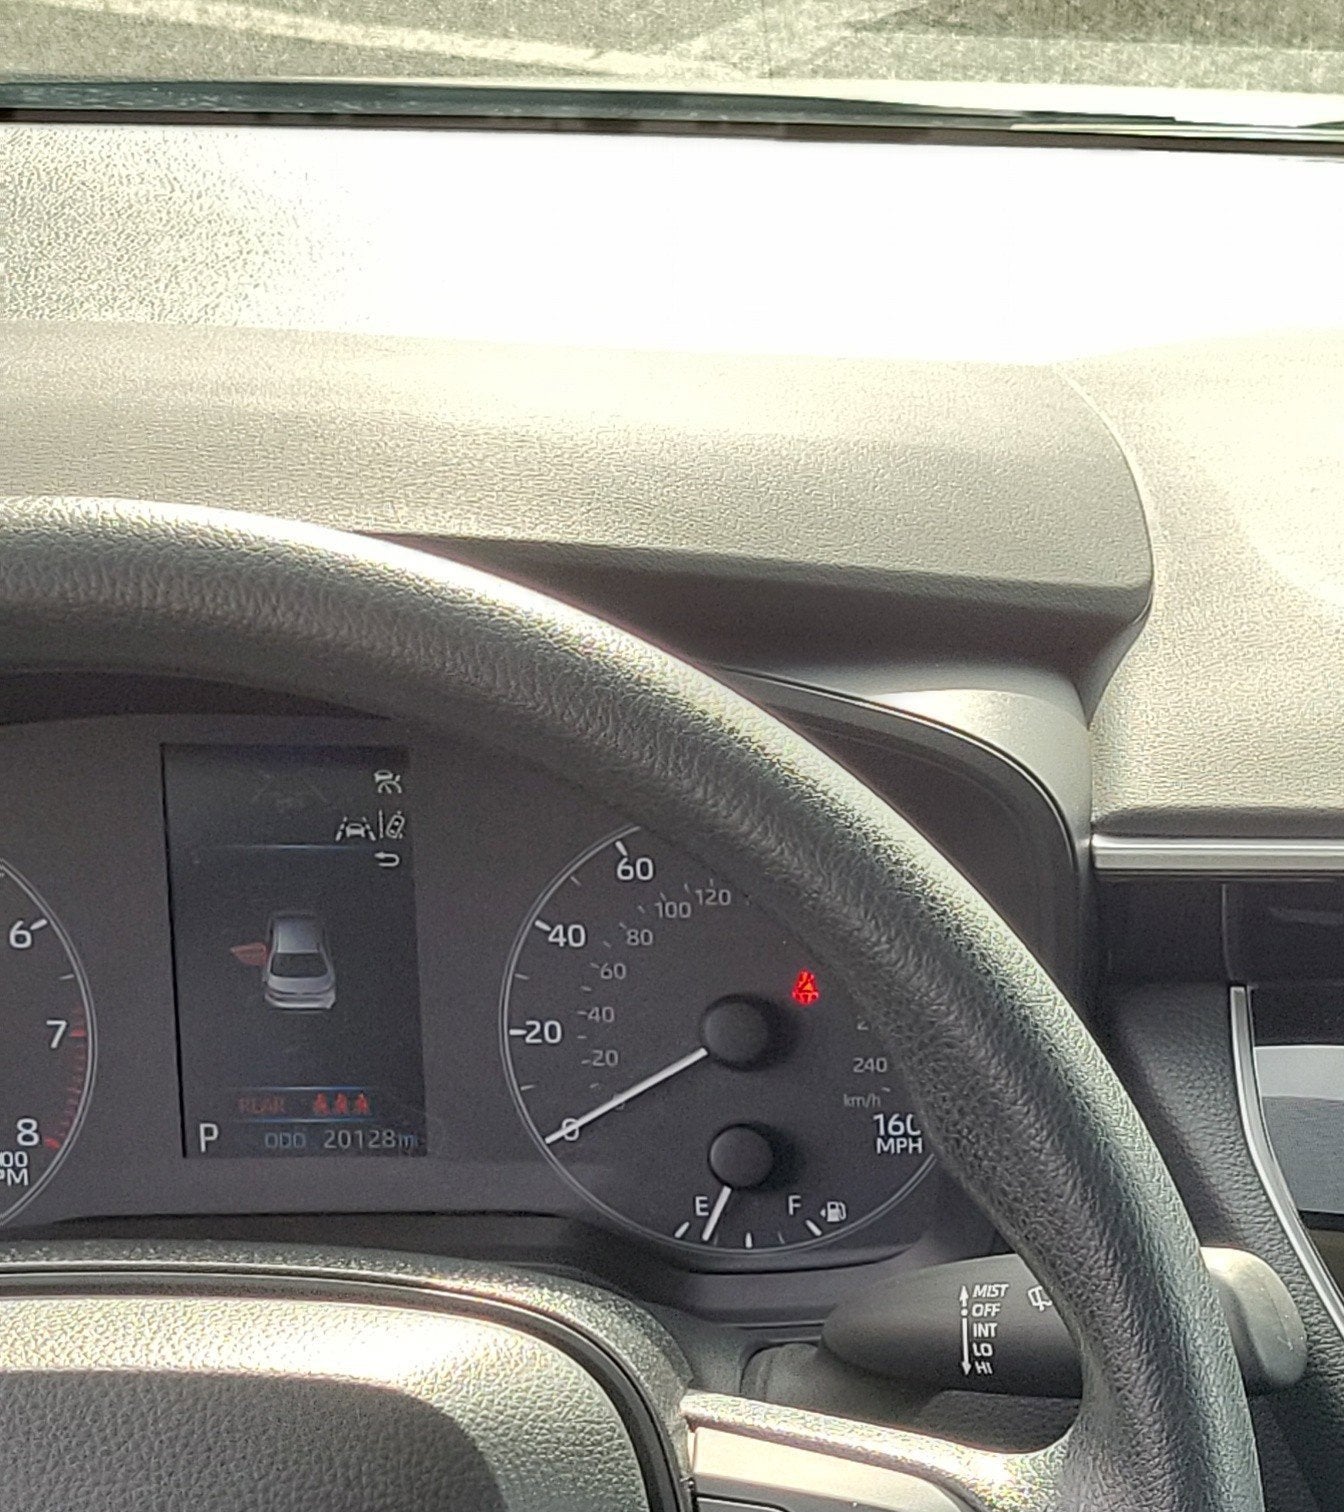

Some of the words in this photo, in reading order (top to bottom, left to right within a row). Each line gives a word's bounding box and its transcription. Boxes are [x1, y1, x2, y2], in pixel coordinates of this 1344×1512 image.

[616, 857, 654, 881] 60
[694, 888, 732, 906] 120
[653, 900, 692, 919] 100
[9, 921, 33, 949] 6
[548, 924, 586, 948] 40
[626, 928, 654, 946] 80
[600, 962, 627, 980] 60
[587, 1006, 615, 1023] 40
[46, 1020, 68, 1049] 7
[524, 1020, 562, 1044] 20
[592, 1049, 619, 1067] 20
[852, 1056, 888, 1073] 240
[843, 1093, 882, 1108] km/h
[16, 1118, 40, 1147] 8
[200, 1122, 219, 1153] P
[323, 1129, 396, 1150] 20128
[876, 1137, 924, 1155] MPH
[695, 1196, 709, 1217] E
[788, 1195, 802, 1216] F
[972, 1283, 1010, 1299] MIST
[971, 1303, 1001, 1318] OFF
[973, 1322, 998, 1339] INT
[972, 1342, 994, 1357] LO
[974, 1360, 993, 1375] HI
